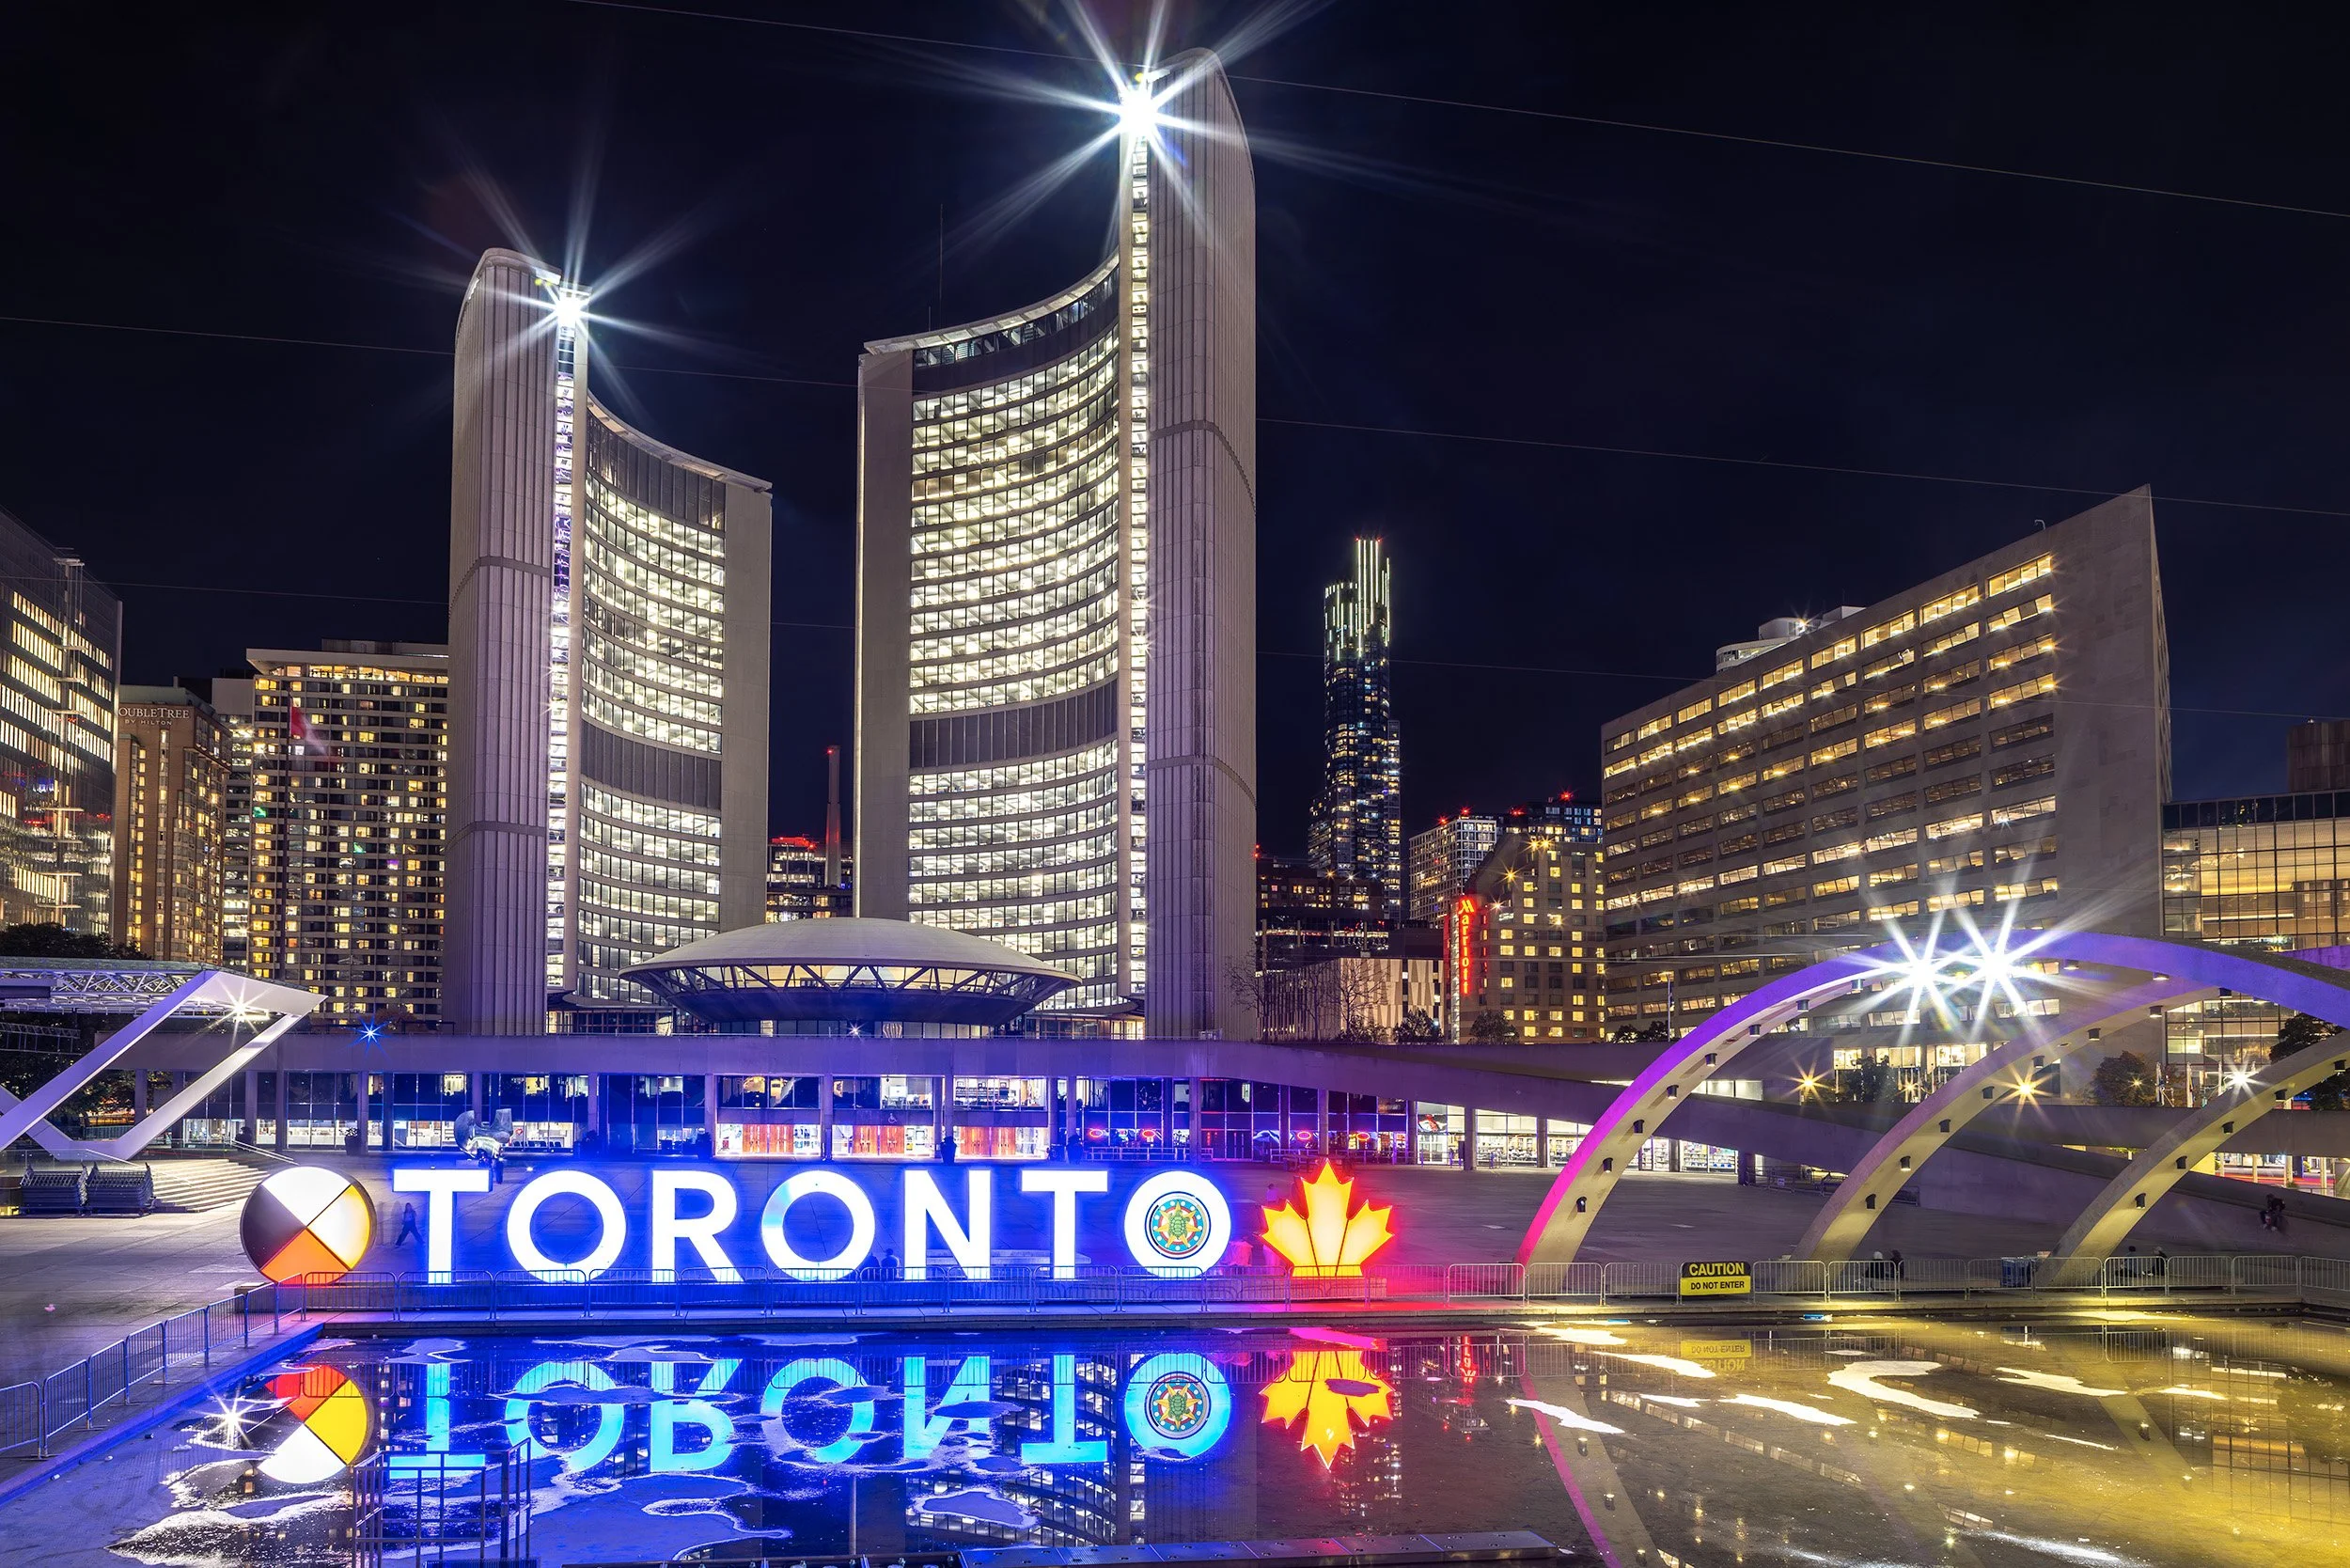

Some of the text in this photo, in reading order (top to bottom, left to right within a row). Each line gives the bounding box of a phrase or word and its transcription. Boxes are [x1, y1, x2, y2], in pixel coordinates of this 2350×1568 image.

[118, 707, 190, 718] OUBLETREE
[1458, 899, 1475, 995] Marriott
[393, 1169, 1231, 1283] TORONTO
[1689, 1262, 1745, 1276] CAUTION
[1720, 1280, 1745, 1289] ENTER
